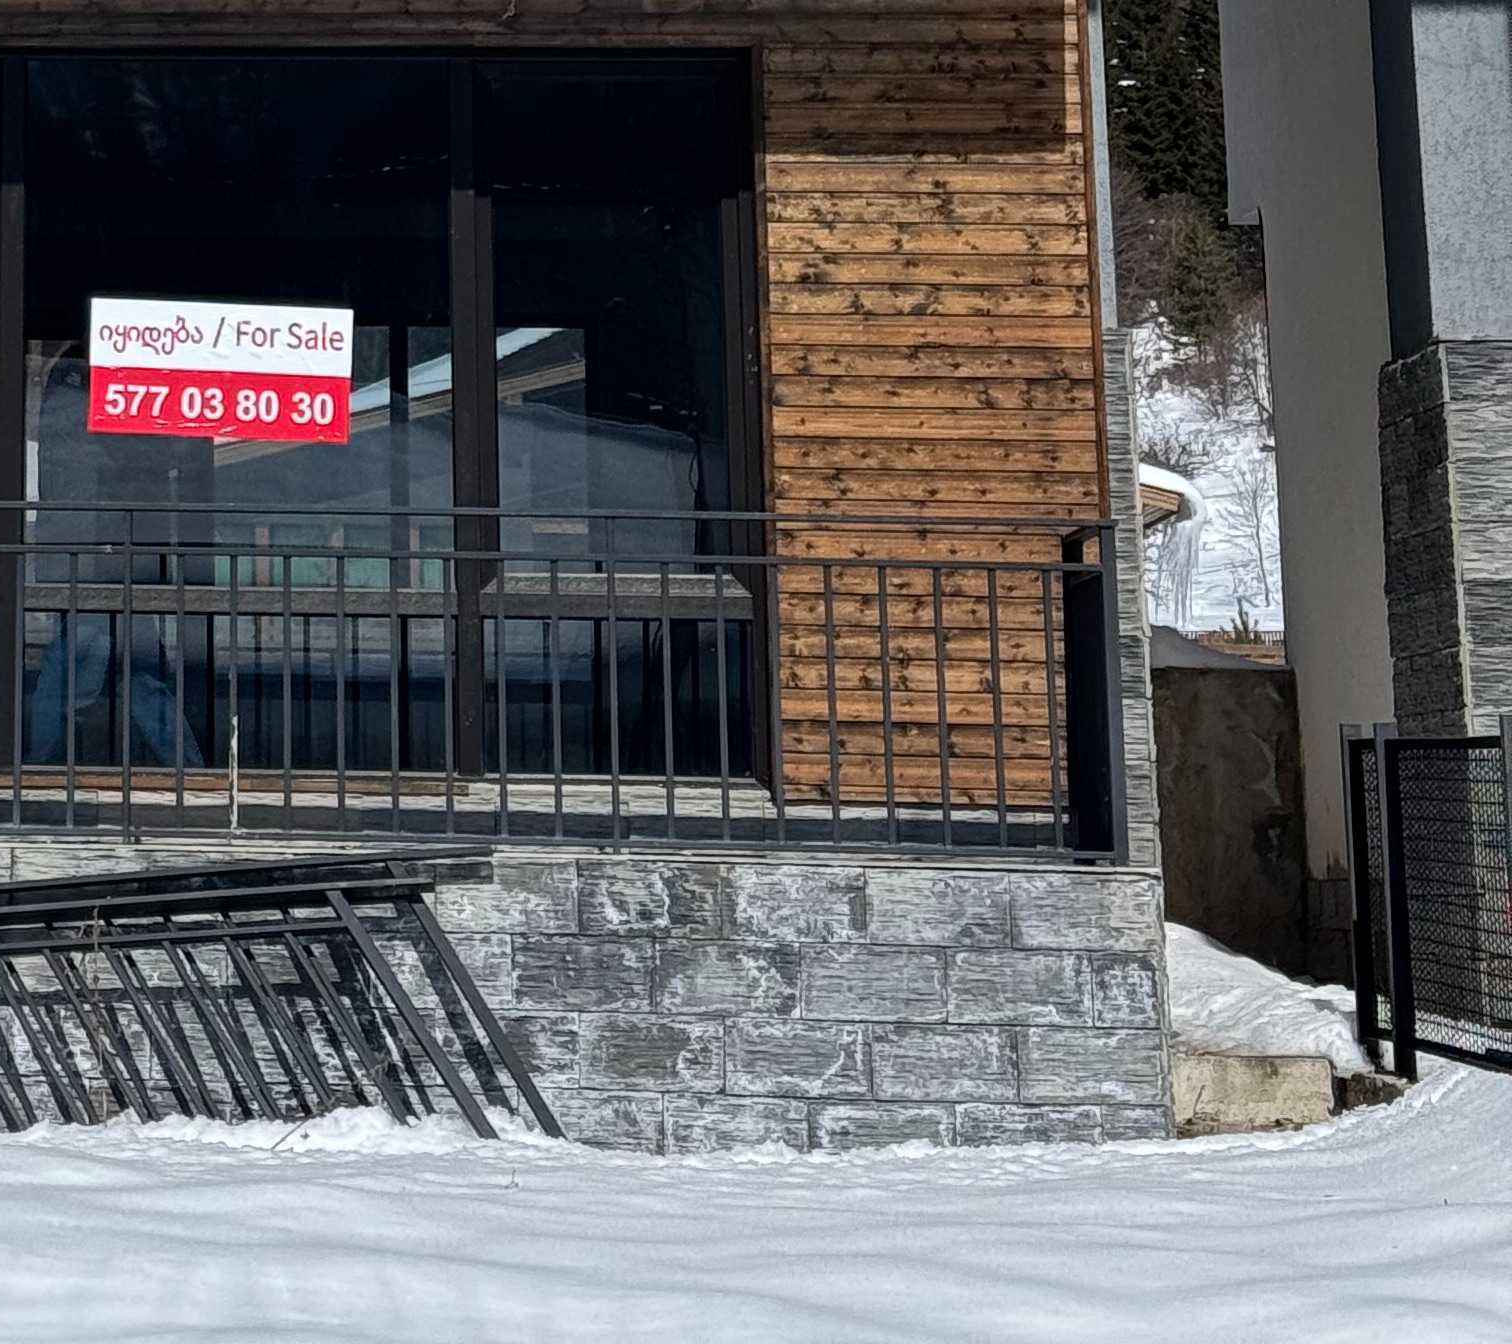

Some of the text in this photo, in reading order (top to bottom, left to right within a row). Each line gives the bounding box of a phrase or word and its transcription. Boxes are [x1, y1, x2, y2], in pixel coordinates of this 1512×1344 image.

[98, 315, 345, 355] იყიდება / For Sale
[103, 383, 335, 426] 577 03 80 30
